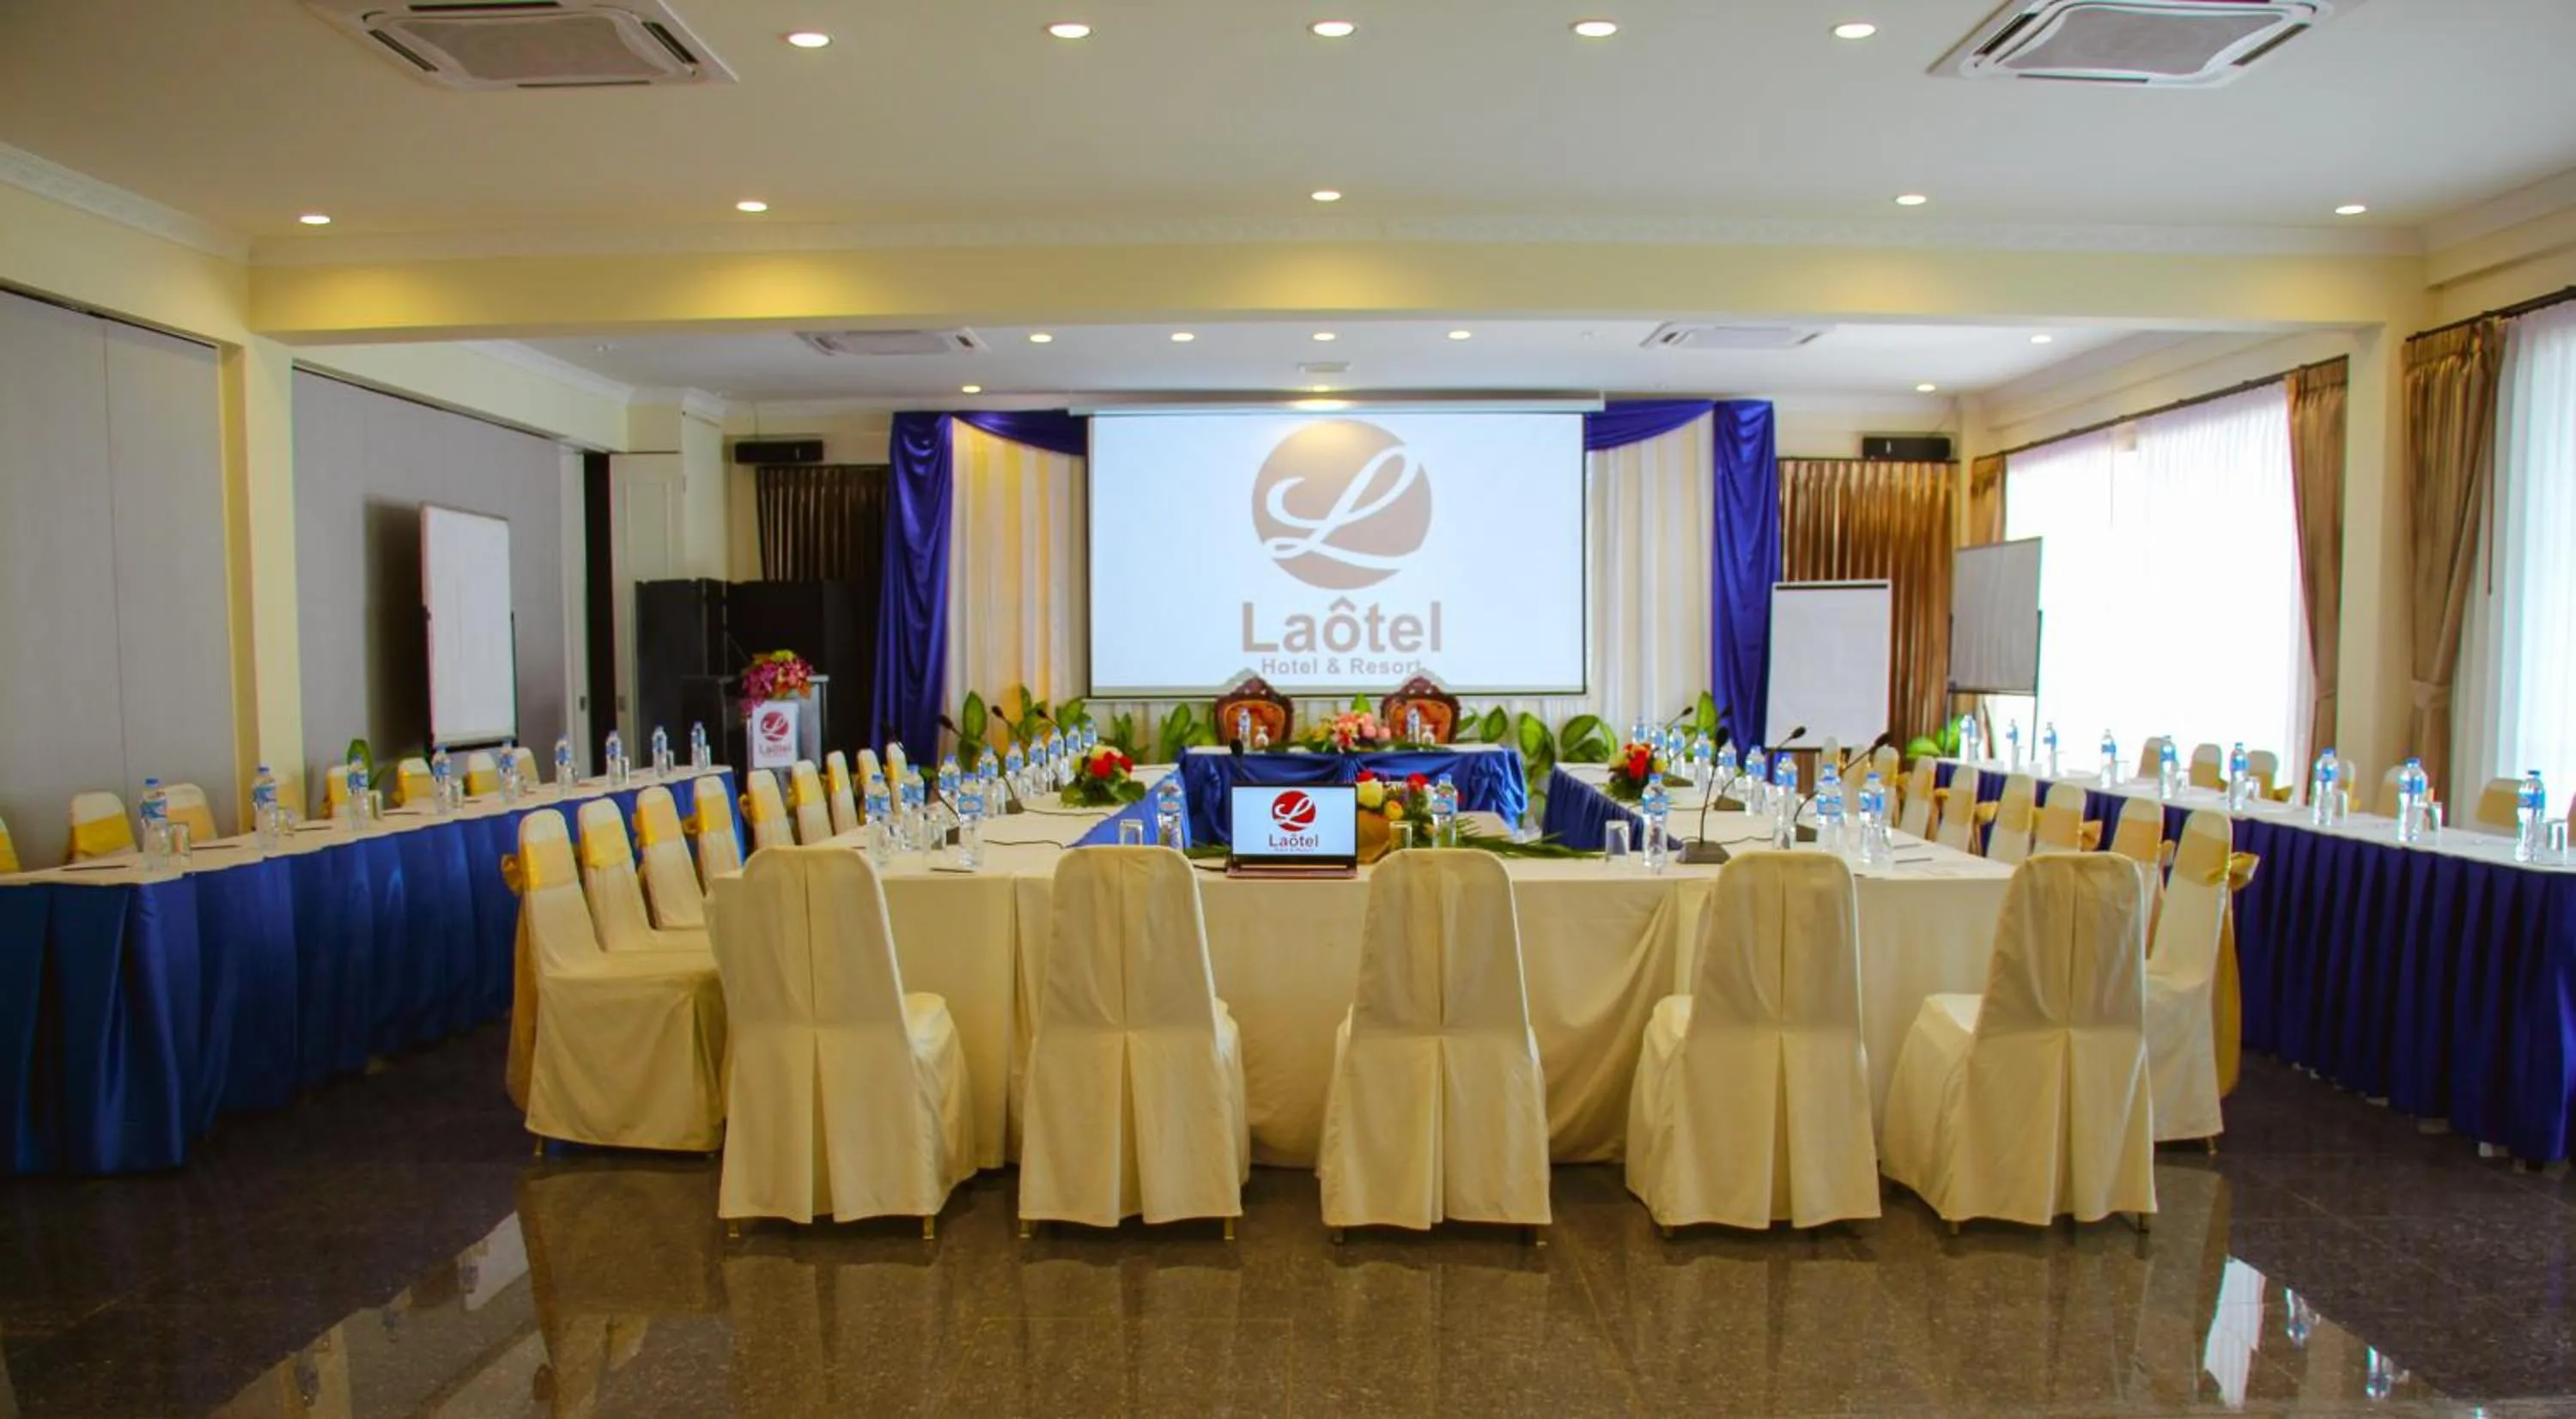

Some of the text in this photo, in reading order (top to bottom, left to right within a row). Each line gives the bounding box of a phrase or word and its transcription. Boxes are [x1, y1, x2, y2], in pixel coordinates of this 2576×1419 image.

[1242, 596, 1442, 653] Laôtel
[1261, 658, 1421, 674] Hotel & Resort
